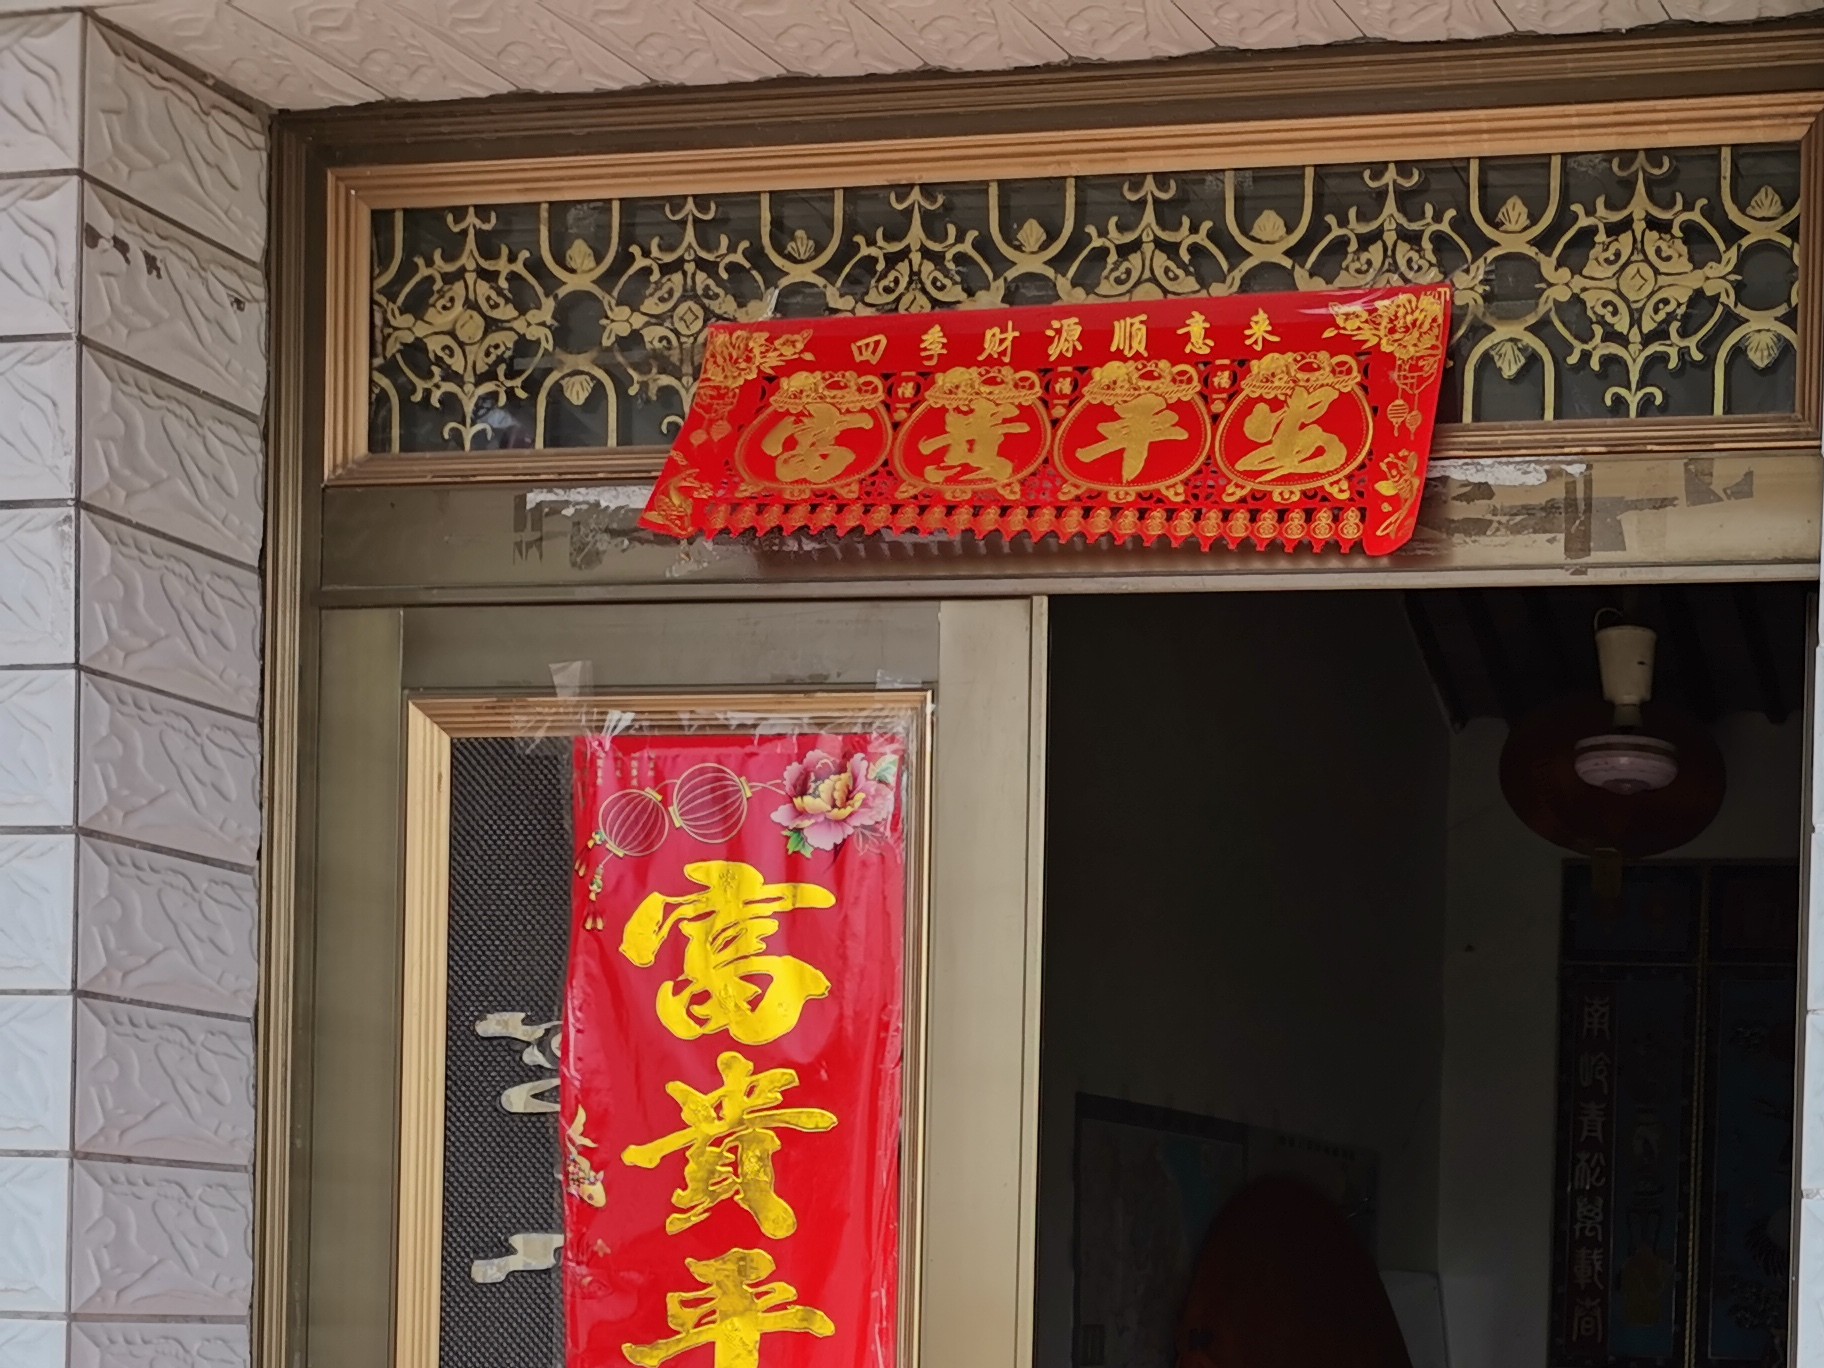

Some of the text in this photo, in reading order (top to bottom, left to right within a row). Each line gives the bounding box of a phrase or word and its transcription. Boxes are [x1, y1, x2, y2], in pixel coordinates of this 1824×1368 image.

[850, 307, 1281, 367] 四季财源顺意来
